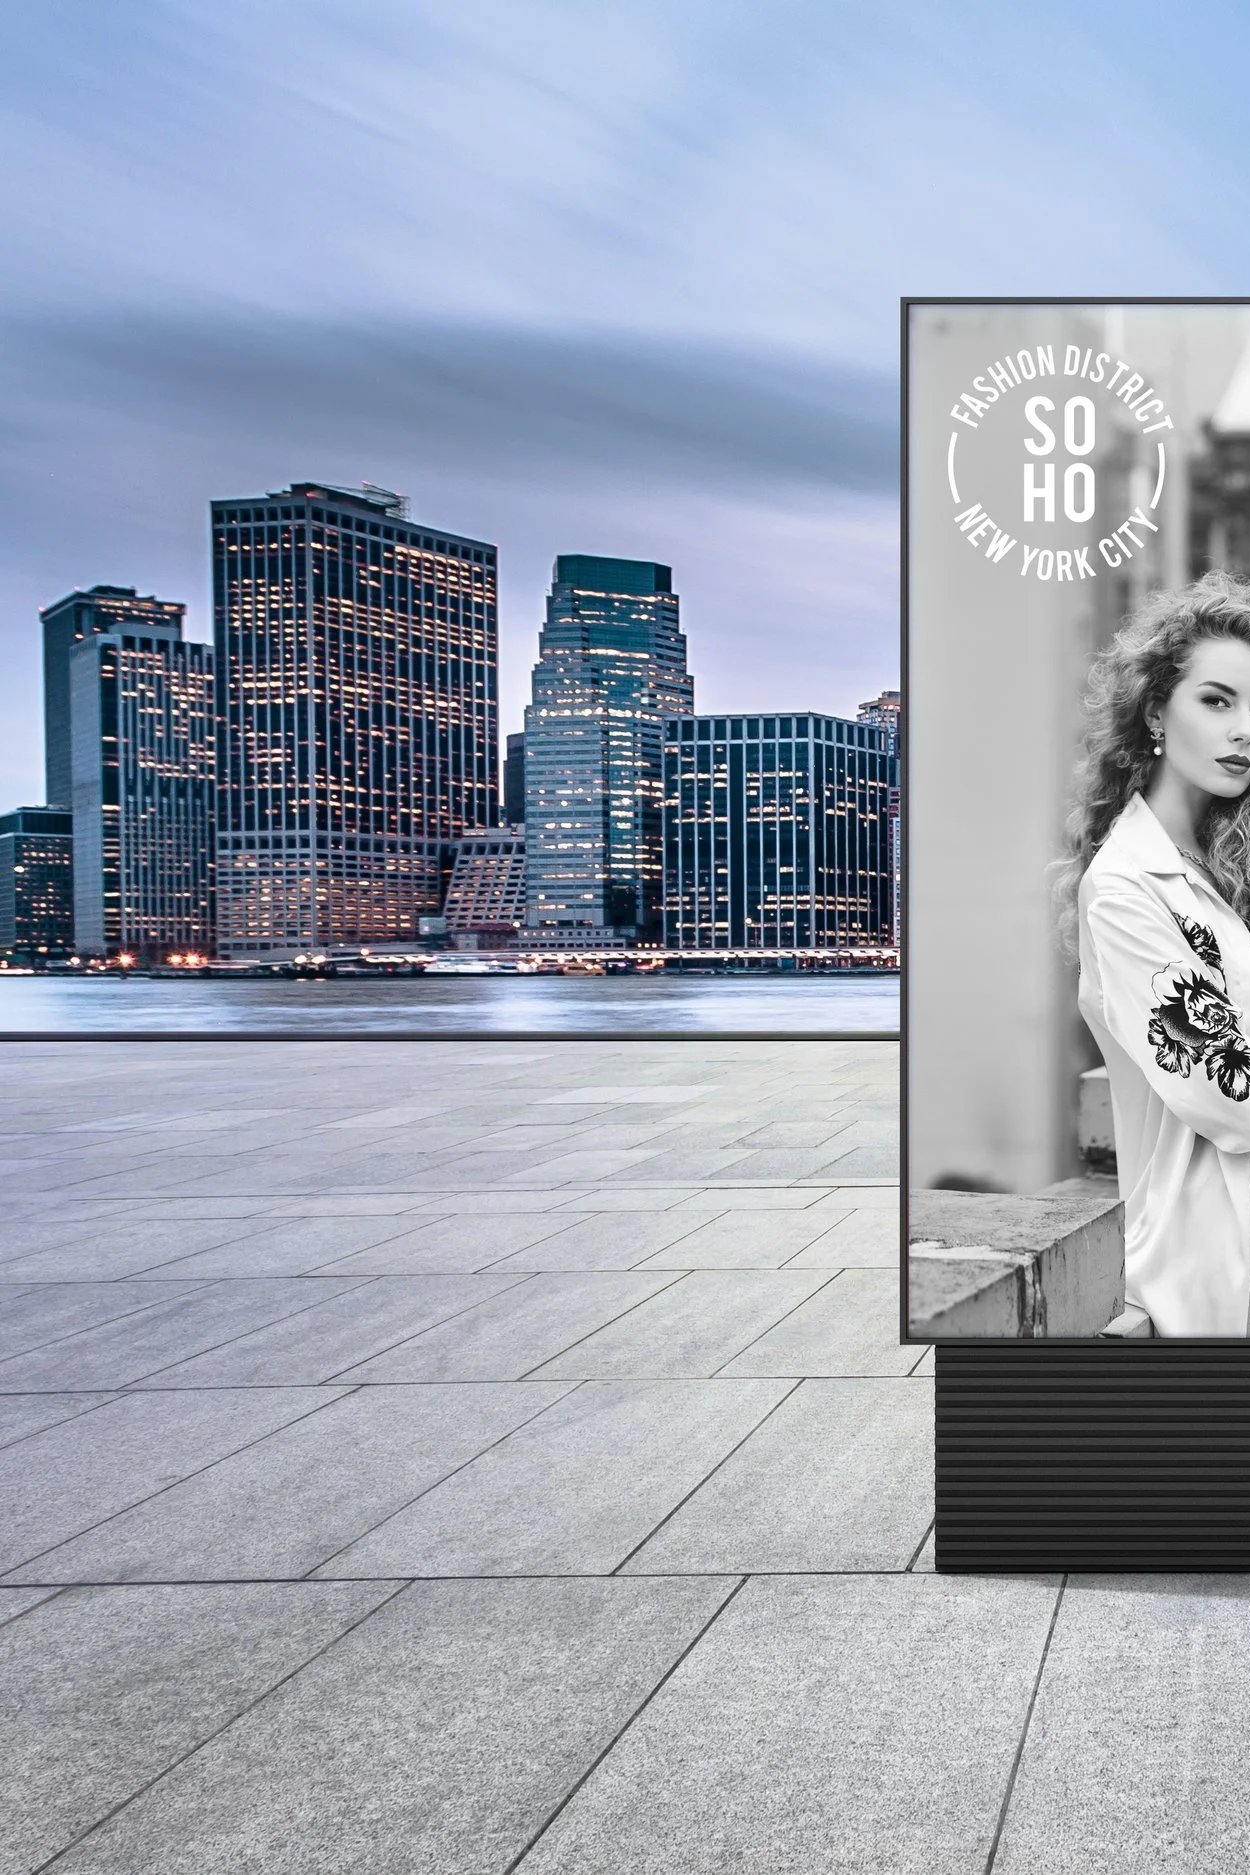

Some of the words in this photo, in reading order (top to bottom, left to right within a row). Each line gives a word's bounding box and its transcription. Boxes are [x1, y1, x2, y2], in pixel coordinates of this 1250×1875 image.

[950, 345, 1055, 428] FASHION
[1064, 345, 1174, 434] DISTRICT
[1024, 396, 1095, 456] SO
[1024, 463, 1095, 522] HO
[954, 503, 1017, 563] NEW
[1021, 545, 1096, 581] YORK
[1099, 507, 1158, 567] CITY
